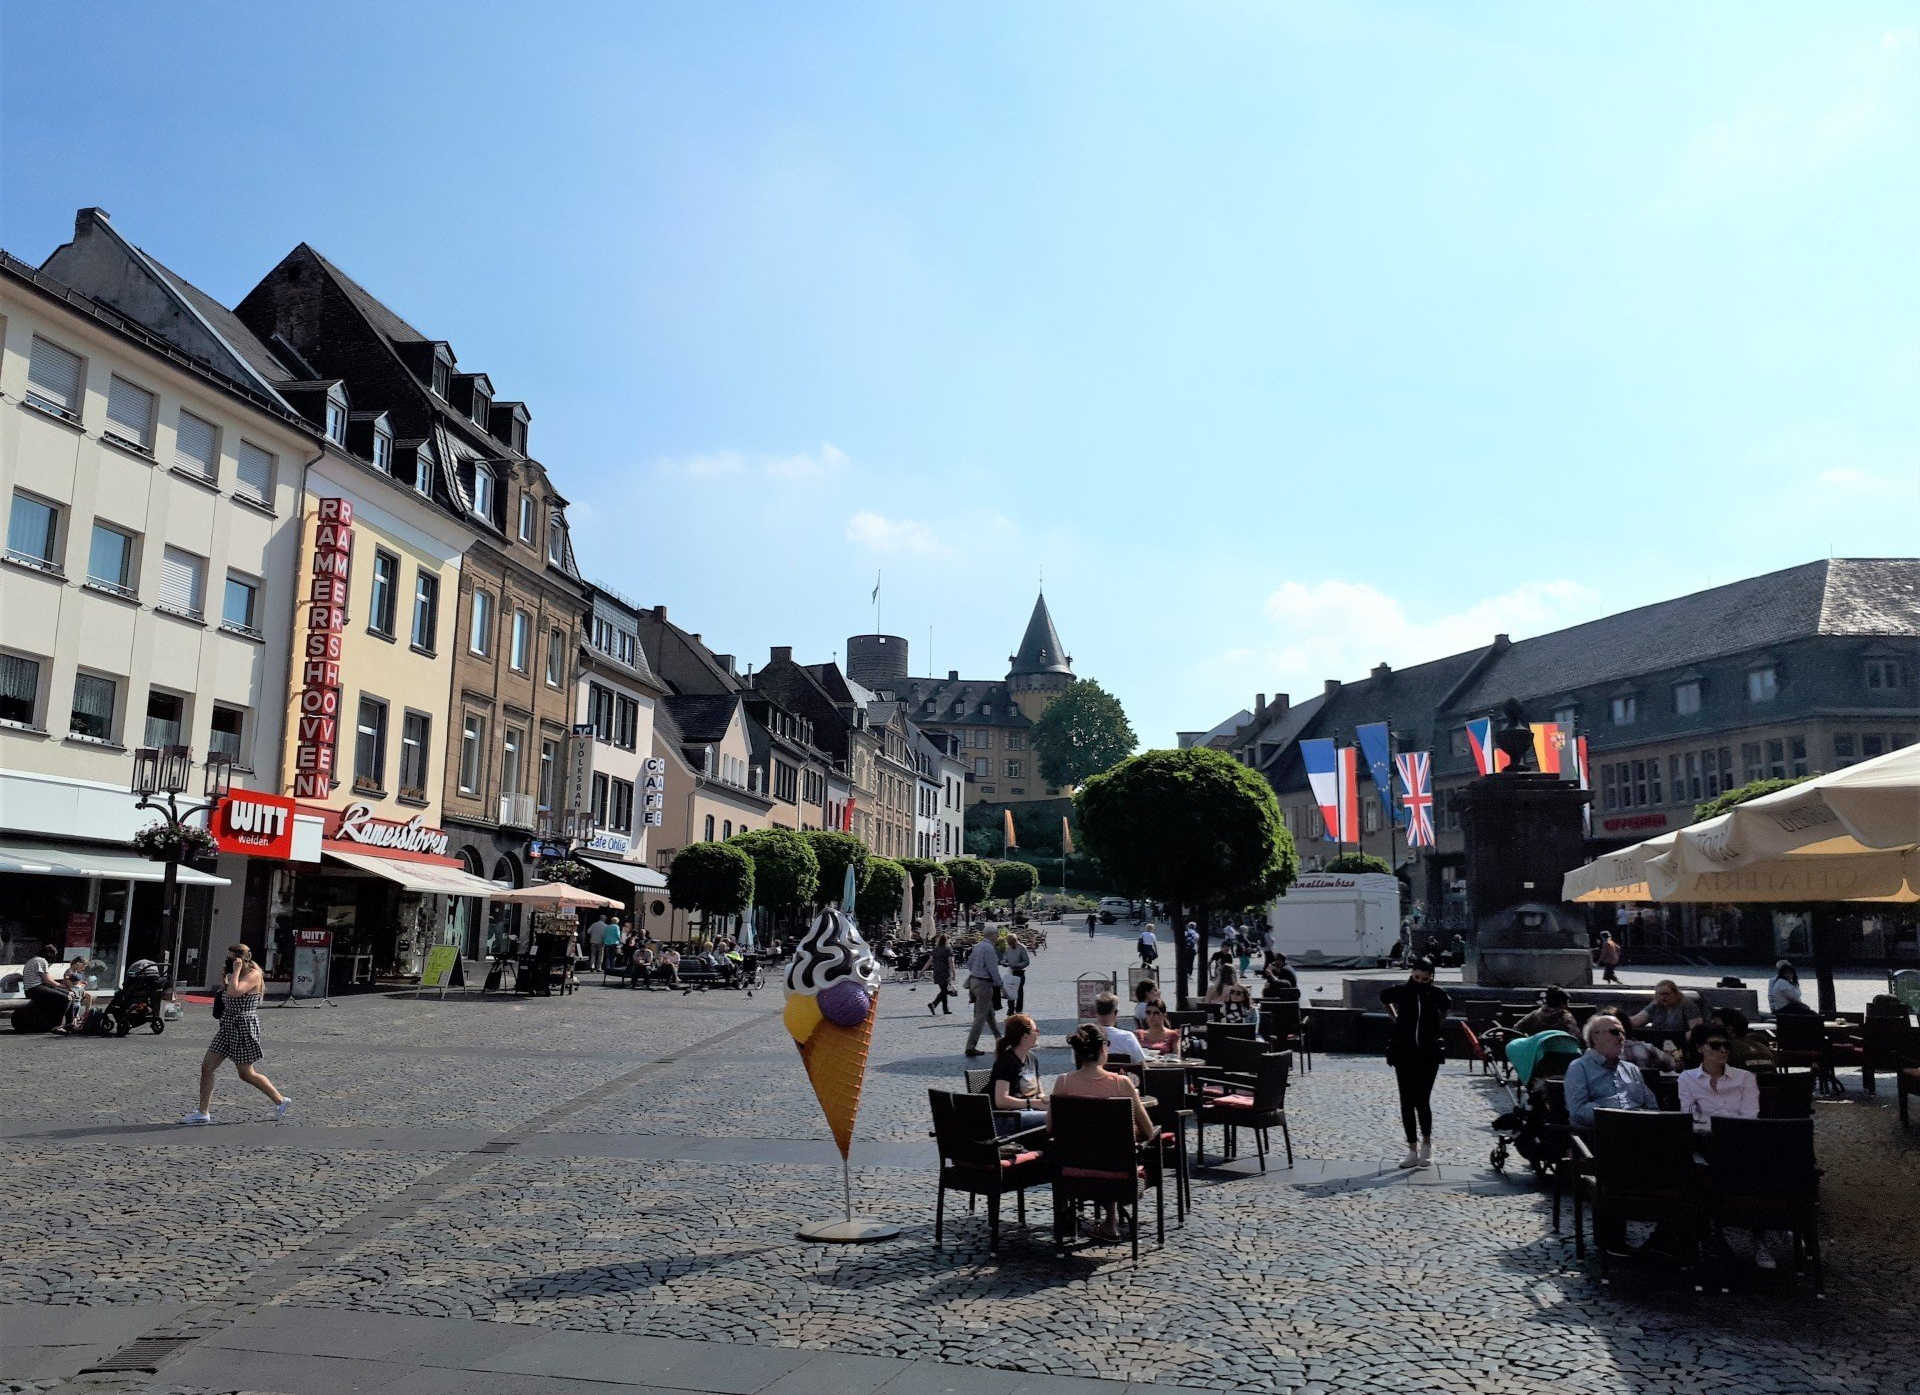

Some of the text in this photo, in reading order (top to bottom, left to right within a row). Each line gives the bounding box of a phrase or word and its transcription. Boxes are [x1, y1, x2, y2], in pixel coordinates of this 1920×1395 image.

[296, 499, 339, 796] RAMERSHOVEN
[315, 500, 352, 798] RAMERSHOVEN
[574, 742, 585, 808] VOLKSBAN
[644, 759, 657, 824] CAFE
[656, 761, 664, 823] CAFE
[230, 799, 288, 836] WITT
[238, 834, 269, 847] weiden
[335, 801, 449, 856] Ramershoven
[301, 930, 326, 940] WITT
